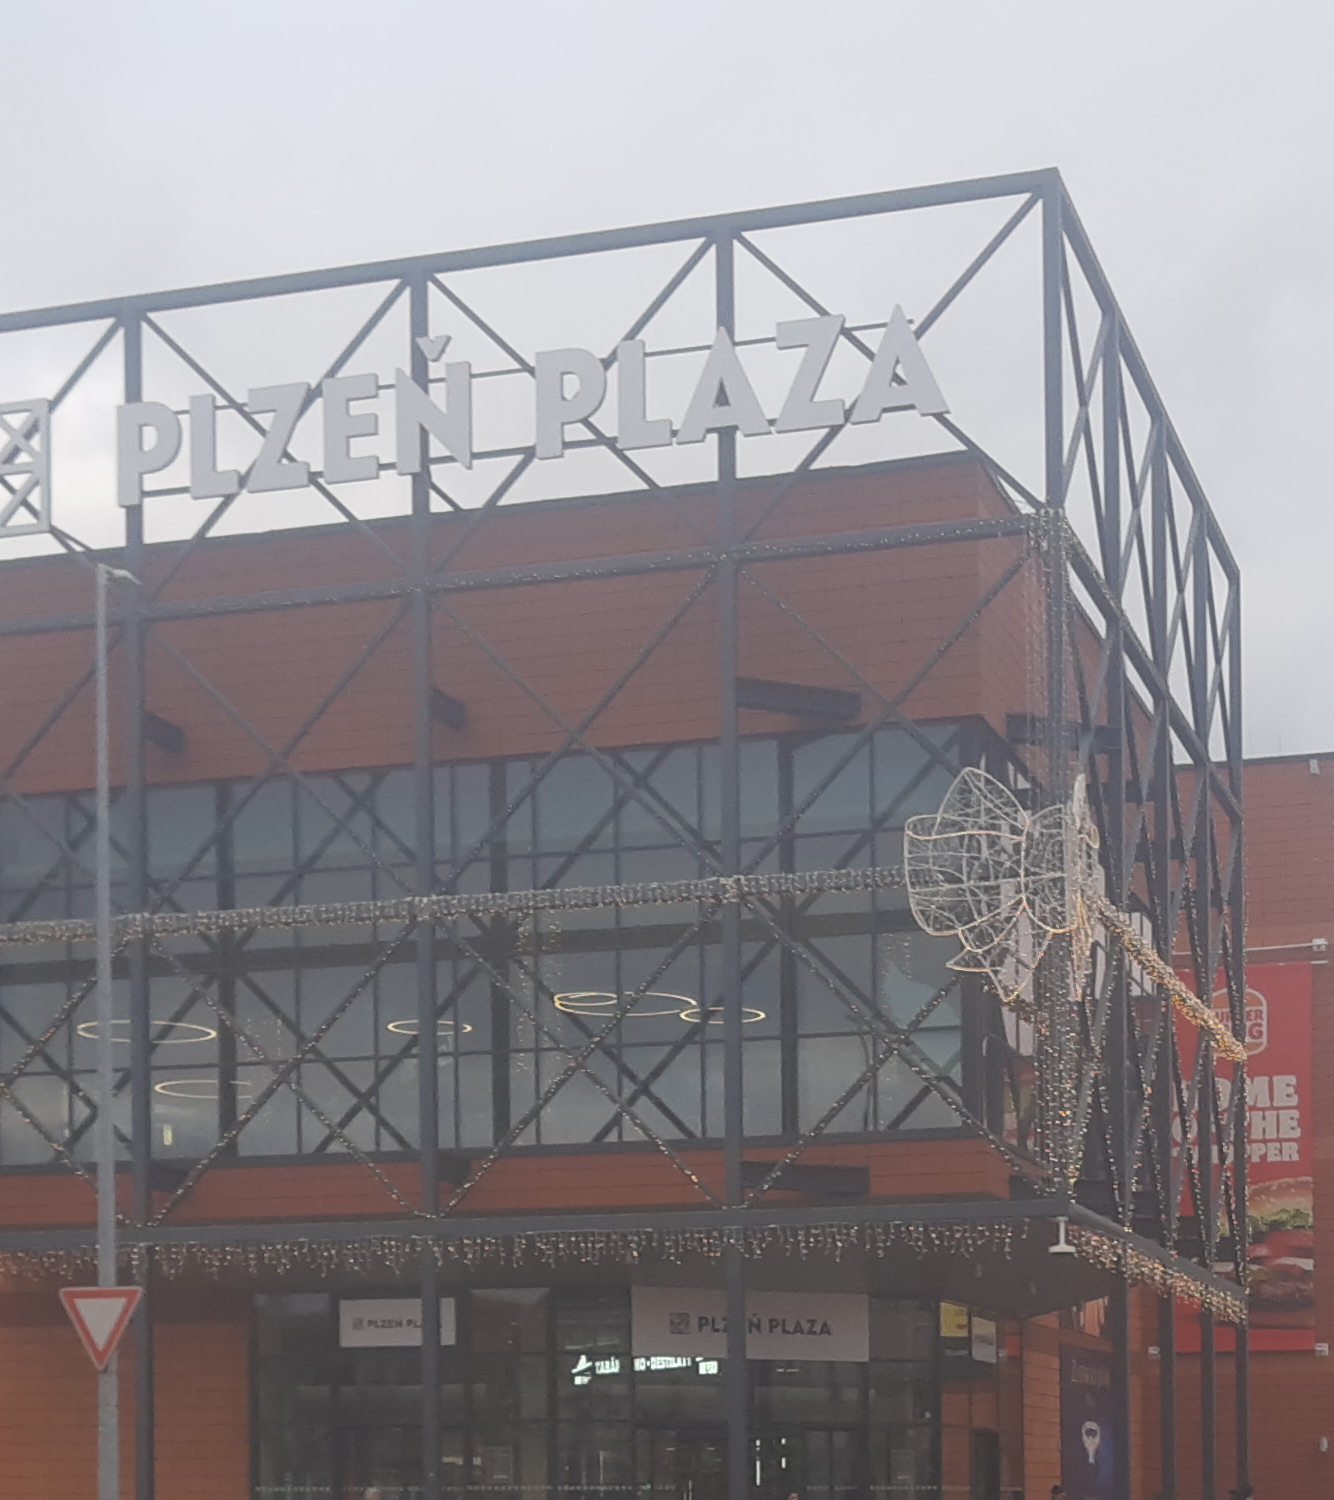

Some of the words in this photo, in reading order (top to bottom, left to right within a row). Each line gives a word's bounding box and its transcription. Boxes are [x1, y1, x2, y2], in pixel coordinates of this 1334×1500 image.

[116, 334, 473, 508] PLZEŇ
[534, 303, 951, 460] PLAZA
[768, 1317, 833, 1336] PLAZA
